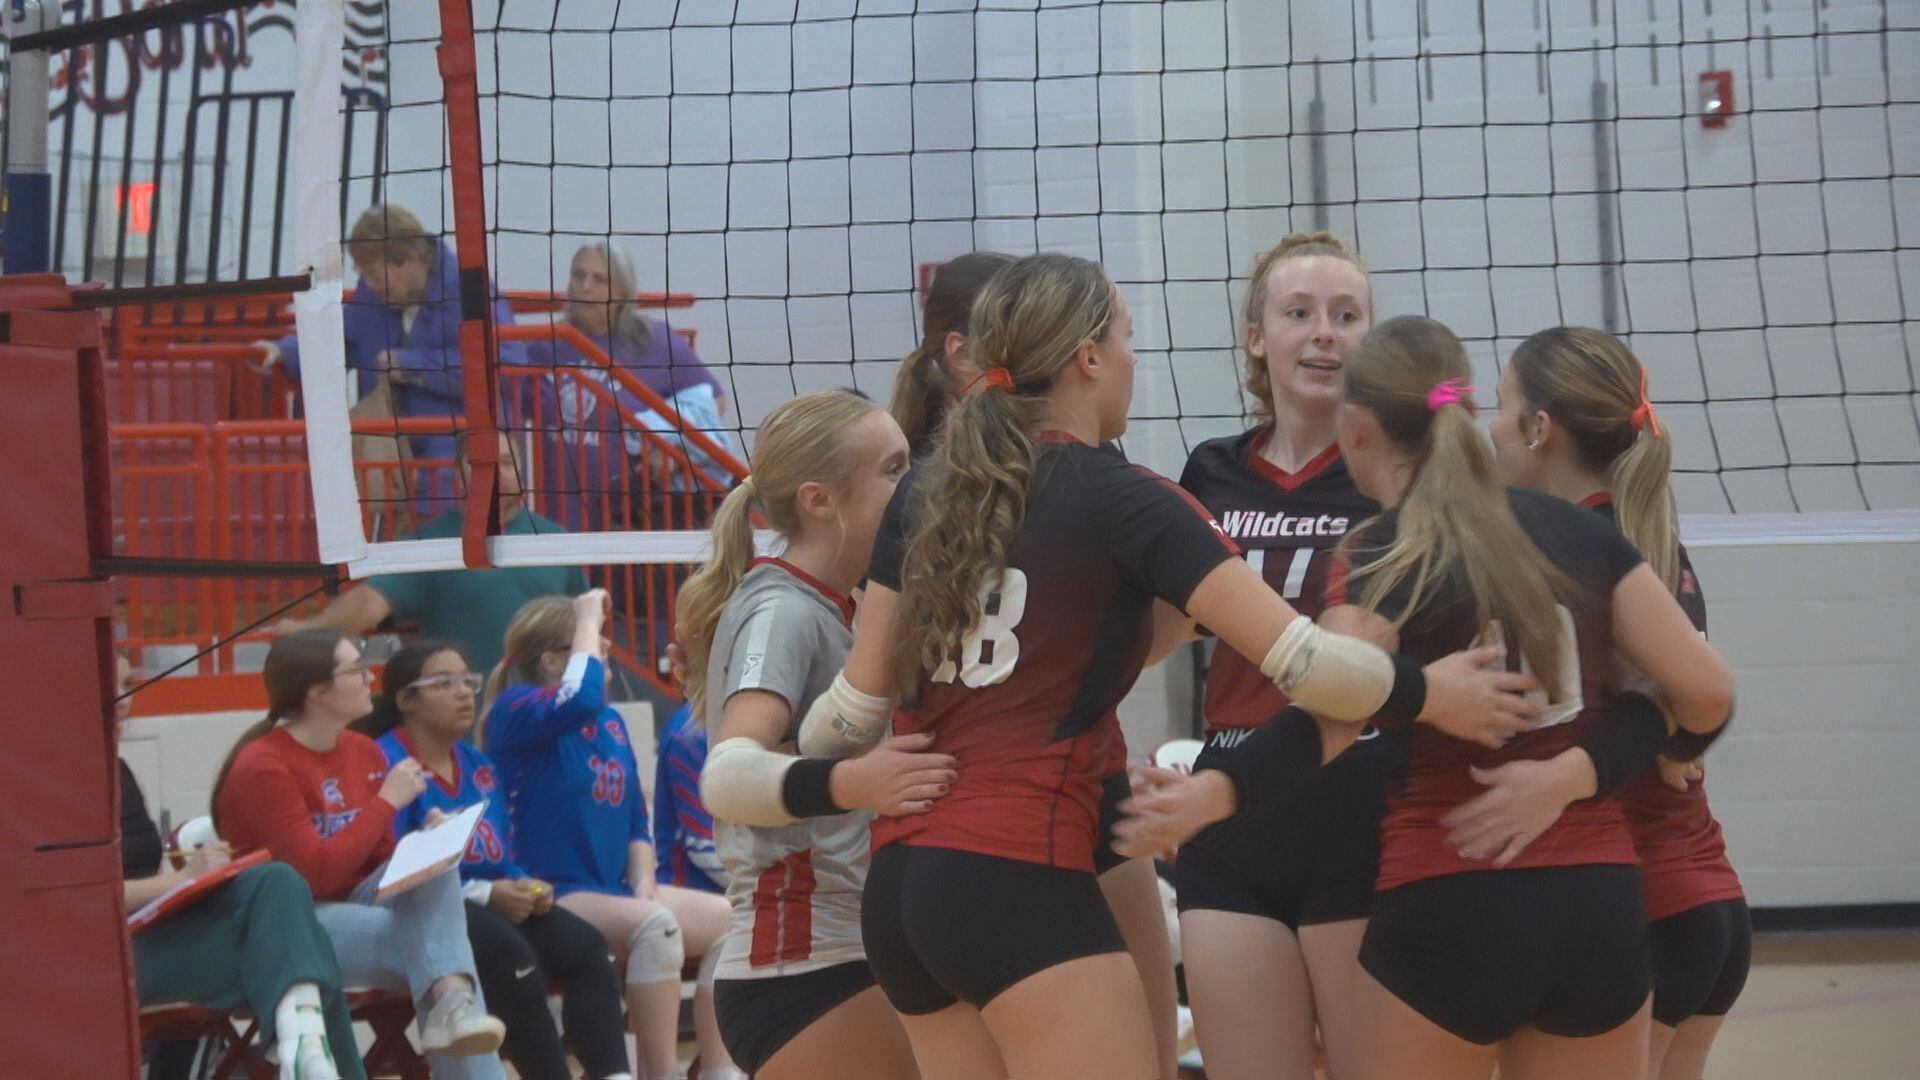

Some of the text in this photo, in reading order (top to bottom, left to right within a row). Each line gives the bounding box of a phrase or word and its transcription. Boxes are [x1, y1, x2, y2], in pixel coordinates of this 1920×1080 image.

[1222, 510, 1349, 538] Wildcats
[930, 566, 1028, 689] 8
[1210, 727, 1256, 748] NIK
